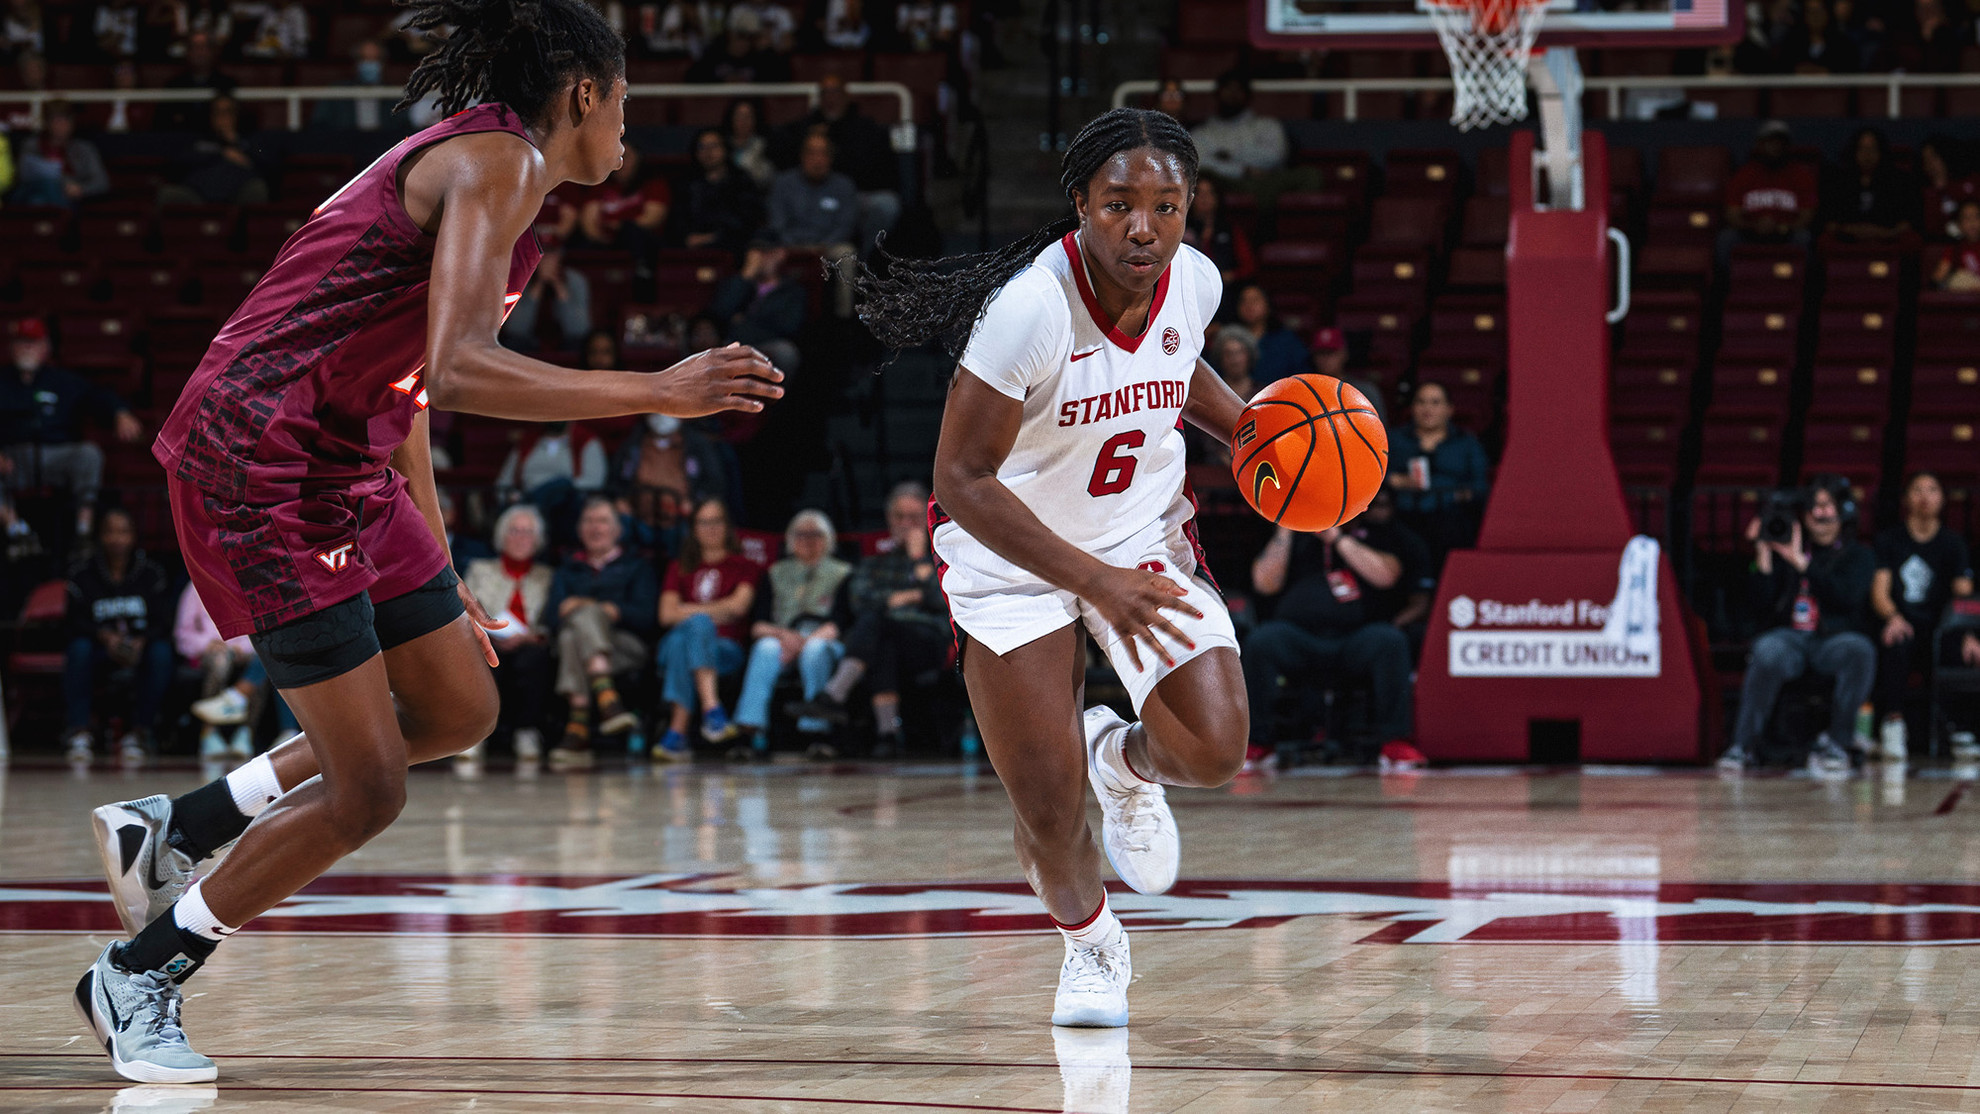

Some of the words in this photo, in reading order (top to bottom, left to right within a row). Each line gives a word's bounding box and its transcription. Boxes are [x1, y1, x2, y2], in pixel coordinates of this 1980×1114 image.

[1058, 380, 1185, 427] STANFORD
[1087, 429, 1146, 498] 6
[317, 541, 354, 571] VT
[1479, 599, 1575, 625] Stanford
[1461, 642, 1552, 666] CREDIT
